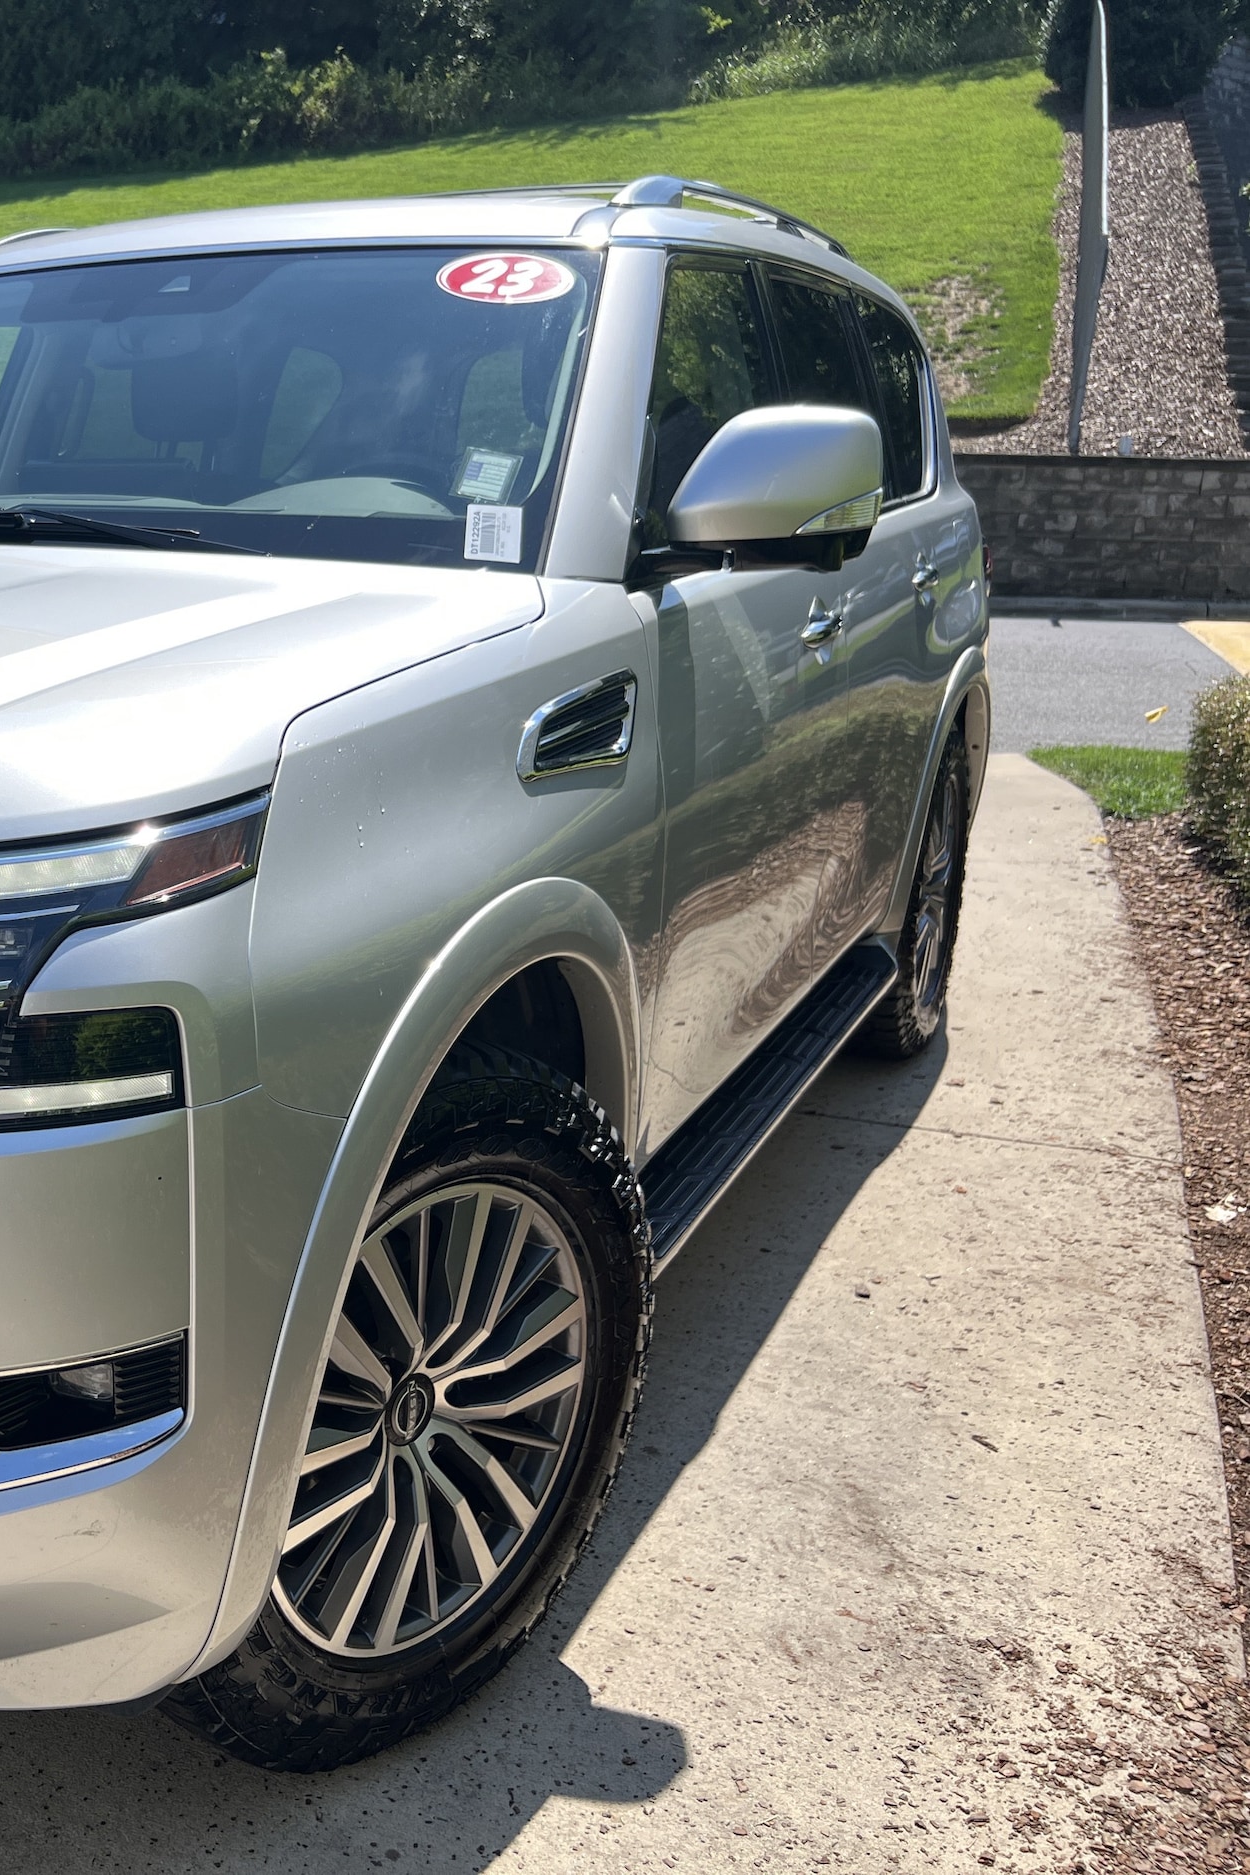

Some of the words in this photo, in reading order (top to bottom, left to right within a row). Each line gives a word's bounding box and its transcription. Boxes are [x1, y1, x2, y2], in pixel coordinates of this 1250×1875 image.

[460, 258, 544, 296] 23
[470, 511, 481, 555] DT12292A
[405, 1380, 417, 1440] NISSAN
